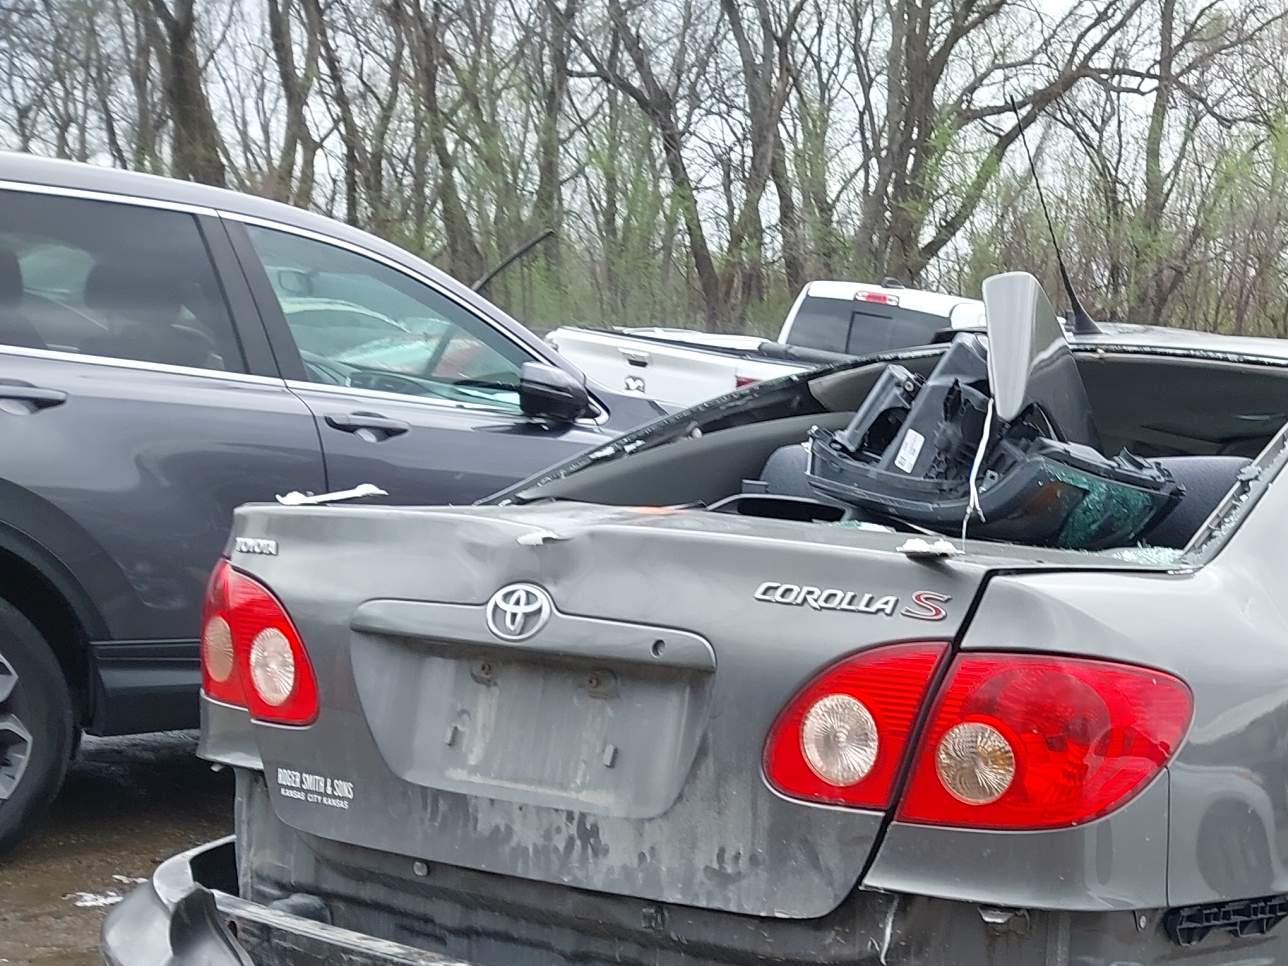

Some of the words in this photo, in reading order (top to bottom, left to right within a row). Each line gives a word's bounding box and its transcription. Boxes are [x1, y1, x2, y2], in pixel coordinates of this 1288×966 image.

[235, 537, 277, 555] TOYOTA
[754, 581, 898, 616] COROLLA
[901, 590, 952, 621] S
[277, 767, 301, 788] ROGER
[302, 772, 325, 793] SMITH
[326, 777, 332, 795] &
[333, 779, 354, 799] SONS
[280, 787, 305, 800] KANSAS
[307, 793, 321, 803] CITY
[322, 797, 349, 809] KANSAS
